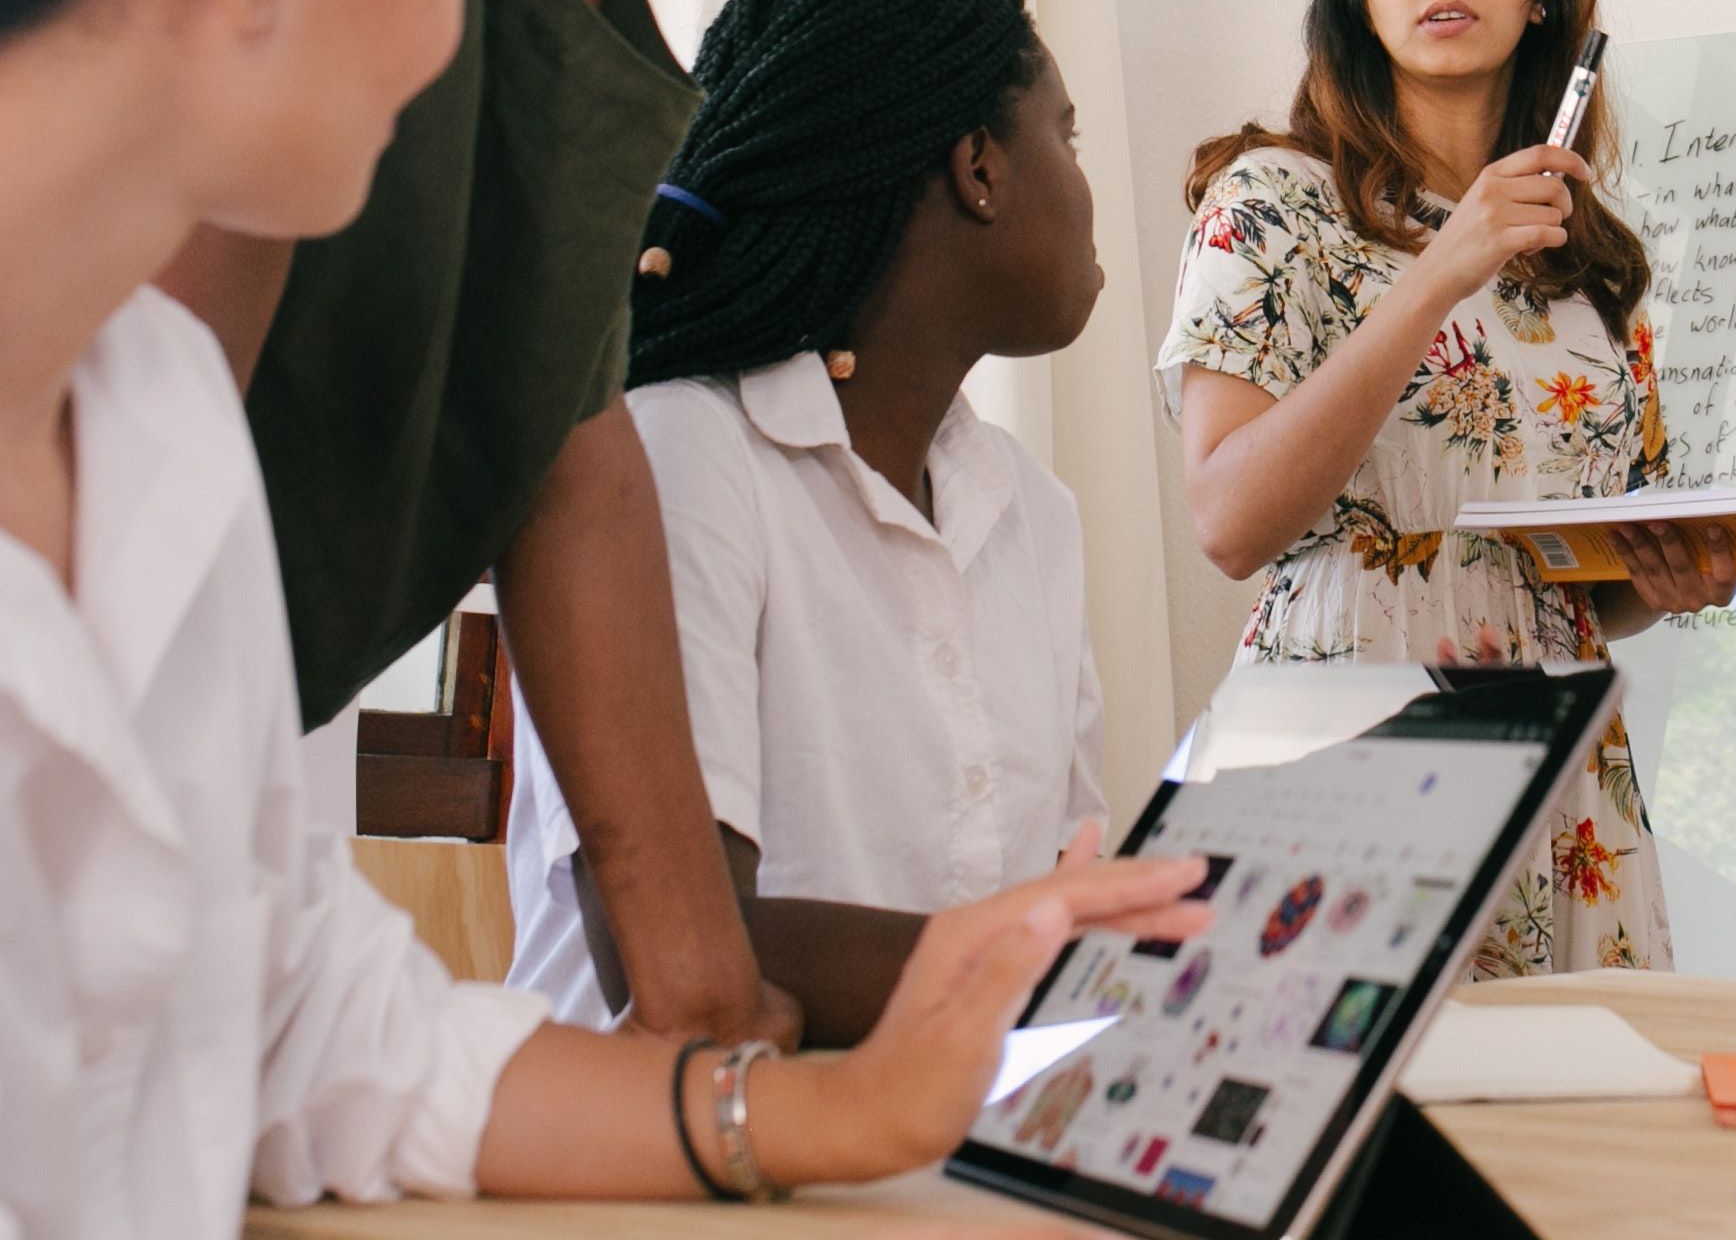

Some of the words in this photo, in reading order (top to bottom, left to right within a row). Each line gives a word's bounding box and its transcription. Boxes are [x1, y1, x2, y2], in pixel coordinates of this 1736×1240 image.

[1639, 210, 1680, 239] how
[1650, 259, 1679, 274] ow
[1693, 381, 1719, 416] of
[1705, 420, 1728, 454] of
